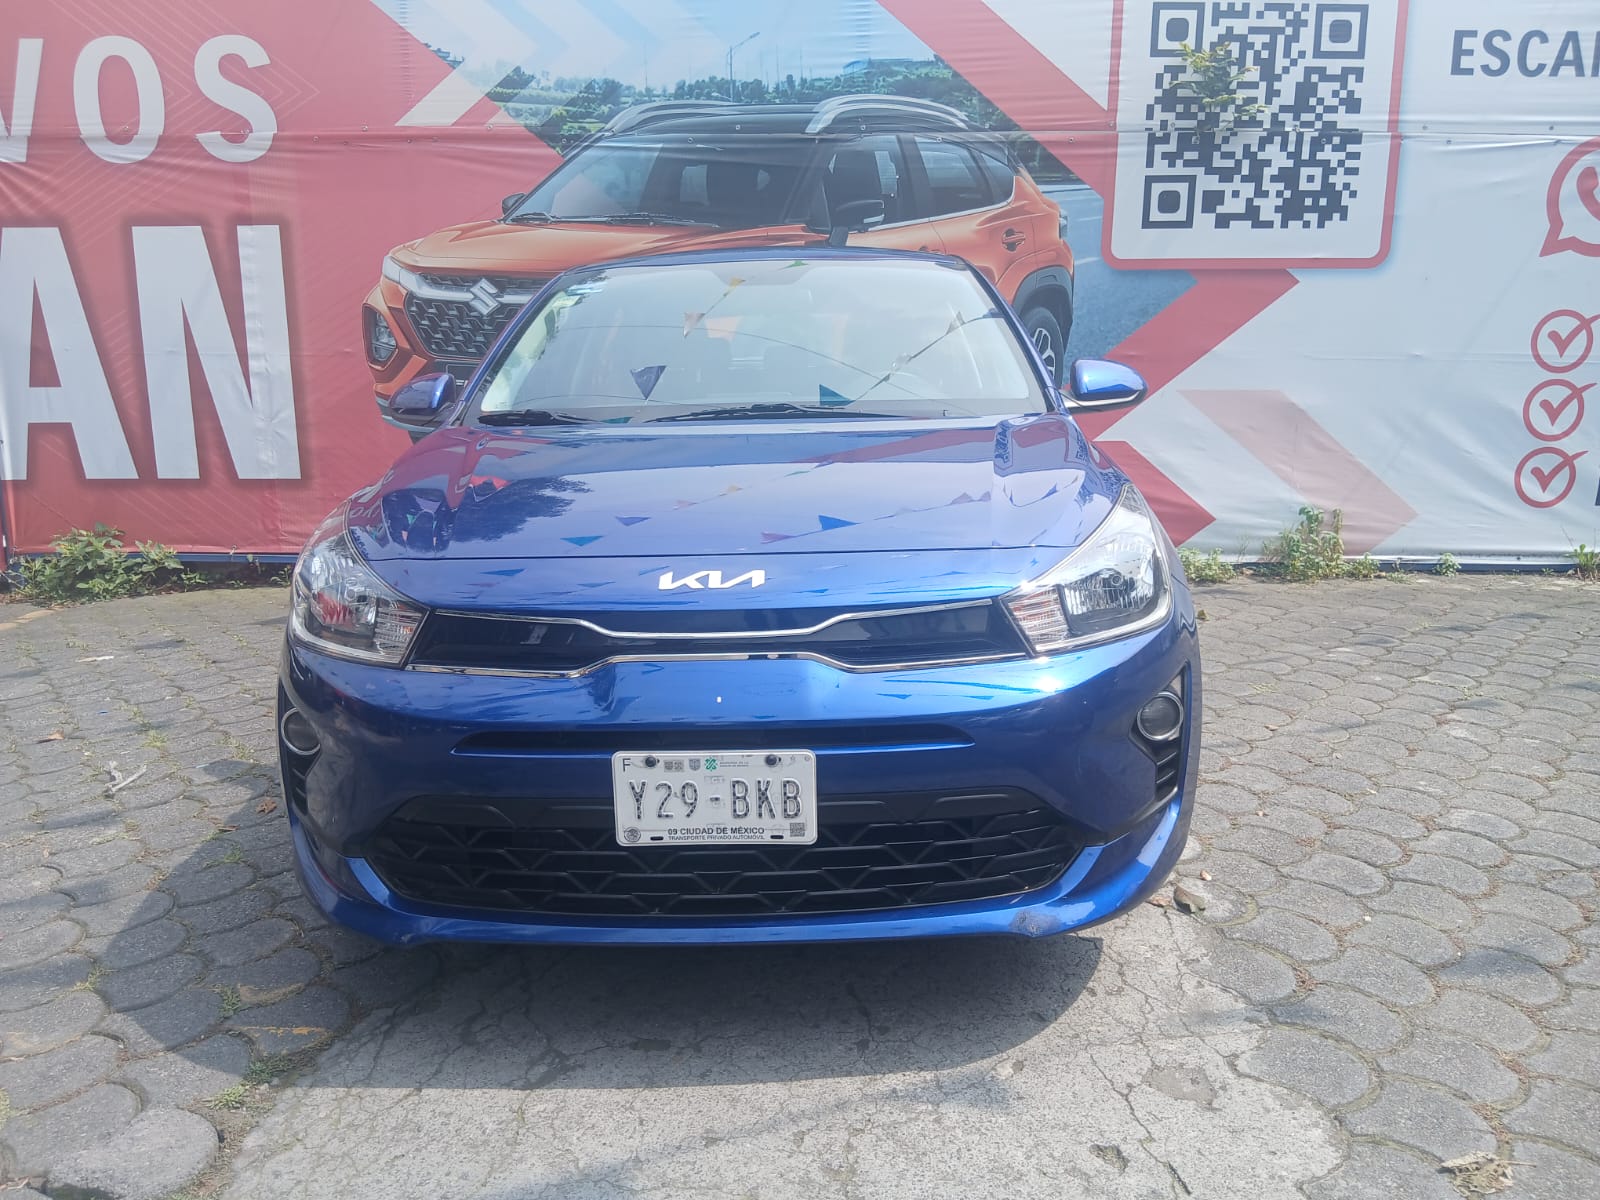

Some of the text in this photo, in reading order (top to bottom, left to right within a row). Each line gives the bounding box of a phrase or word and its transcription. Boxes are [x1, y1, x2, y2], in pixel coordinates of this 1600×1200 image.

[1450, 29, 1600, 77] ESCA
[658, 569, 766, 590] KIA
[622, 758, 631, 772] F
[628, 778, 802, 820] Y29-BKB
[680, 827, 714, 835] CIUDAD
[730, 826, 765, 834] MÉXICO
